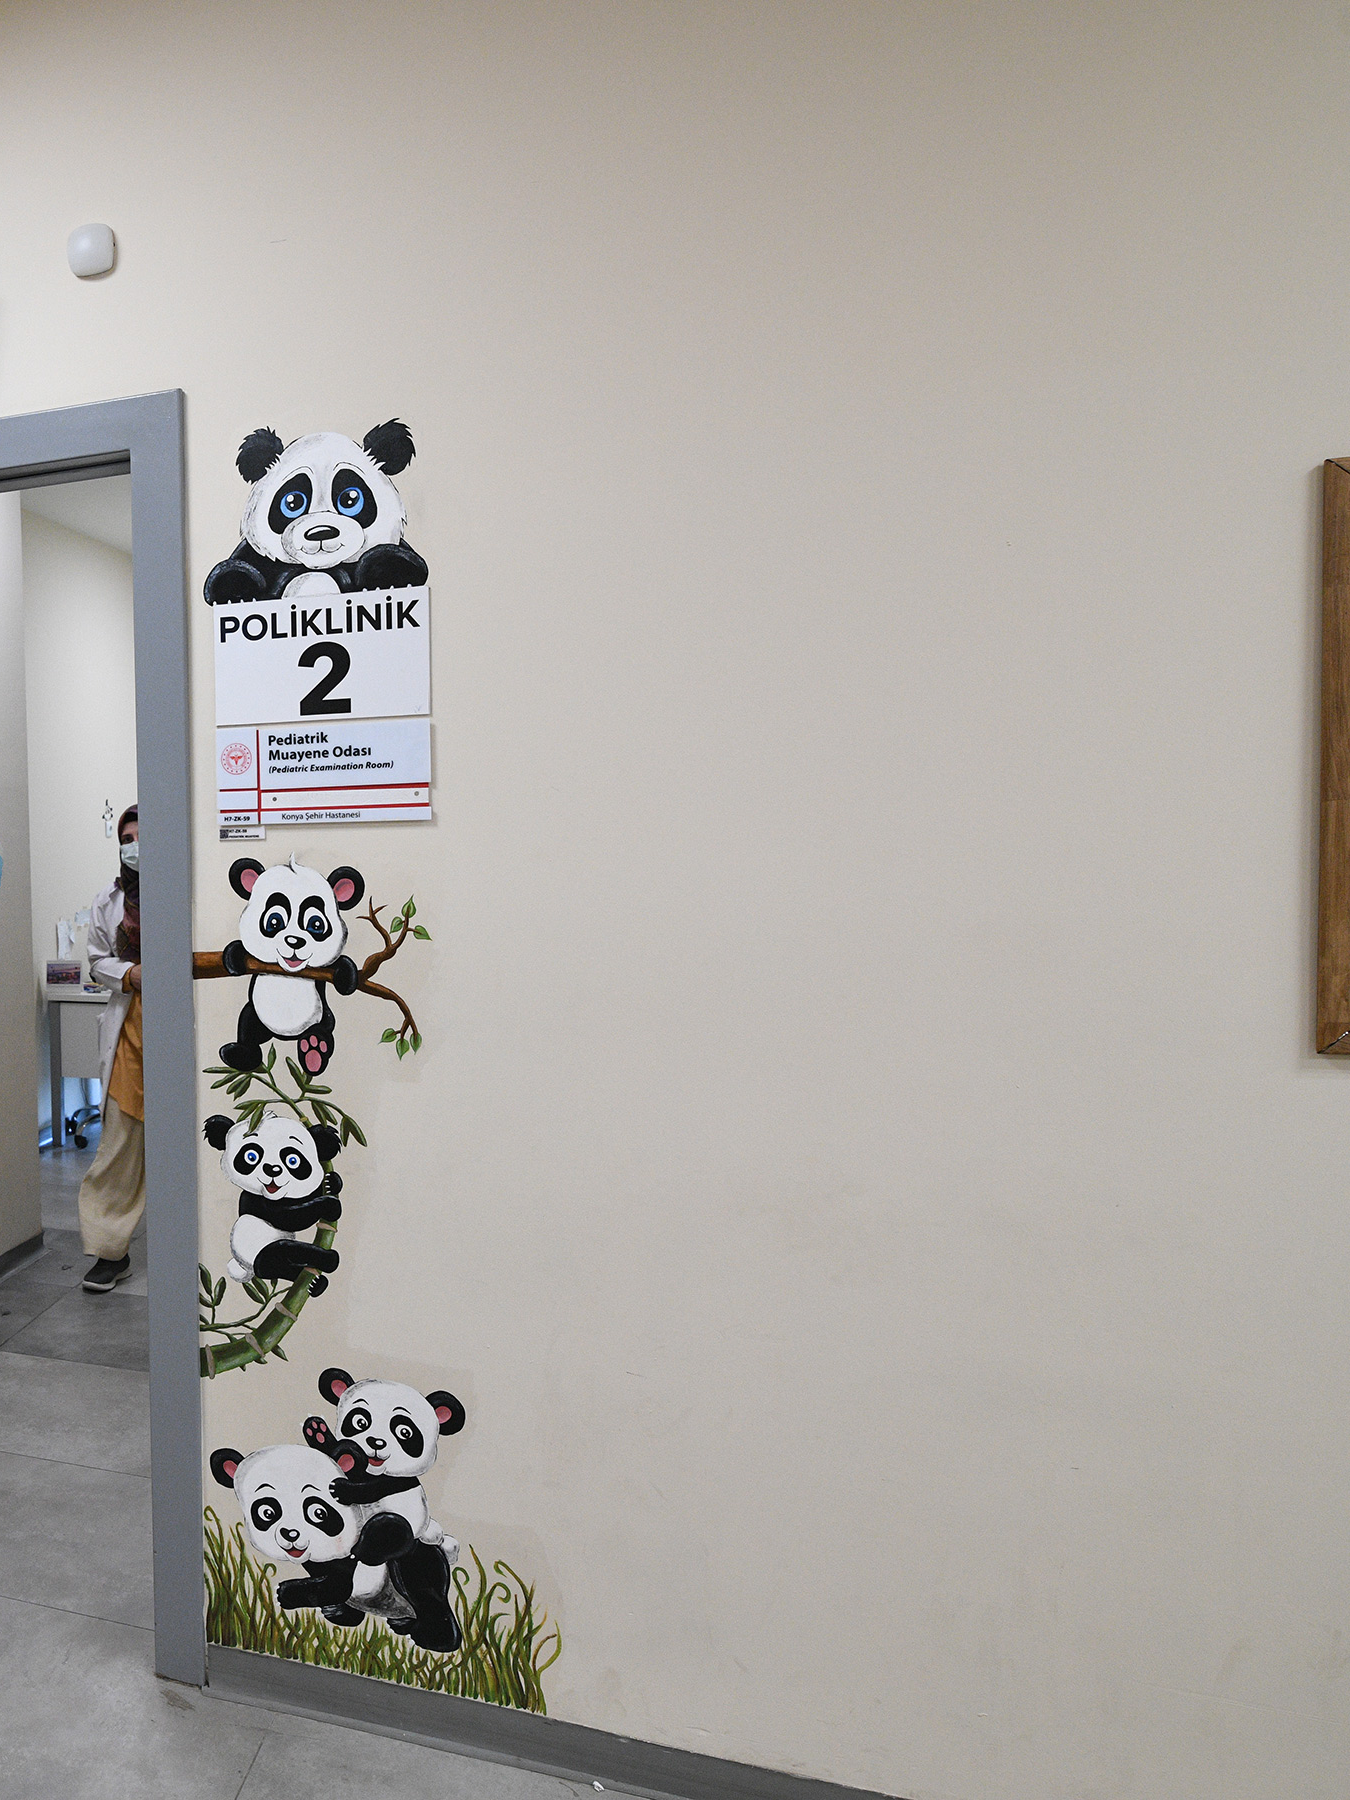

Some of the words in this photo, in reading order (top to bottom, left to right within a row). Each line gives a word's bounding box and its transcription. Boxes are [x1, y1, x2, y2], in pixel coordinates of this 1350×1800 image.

[219, 595, 421, 643] POLİKLİNİK
[297, 641, 352, 716] 2
[268, 732, 329, 746] Pediatrik
[268, 749, 329, 762] Muayene
[332, 745, 372, 758] Odası
[268, 764, 308, 774] (Pediatric
[310, 762, 364, 772] Examination
[365, 760, 394, 769] Room)
[281, 813, 304, 821] Konya
[305, 812, 324, 821] Şehir
[325, 811, 361, 819] Hastanesi
